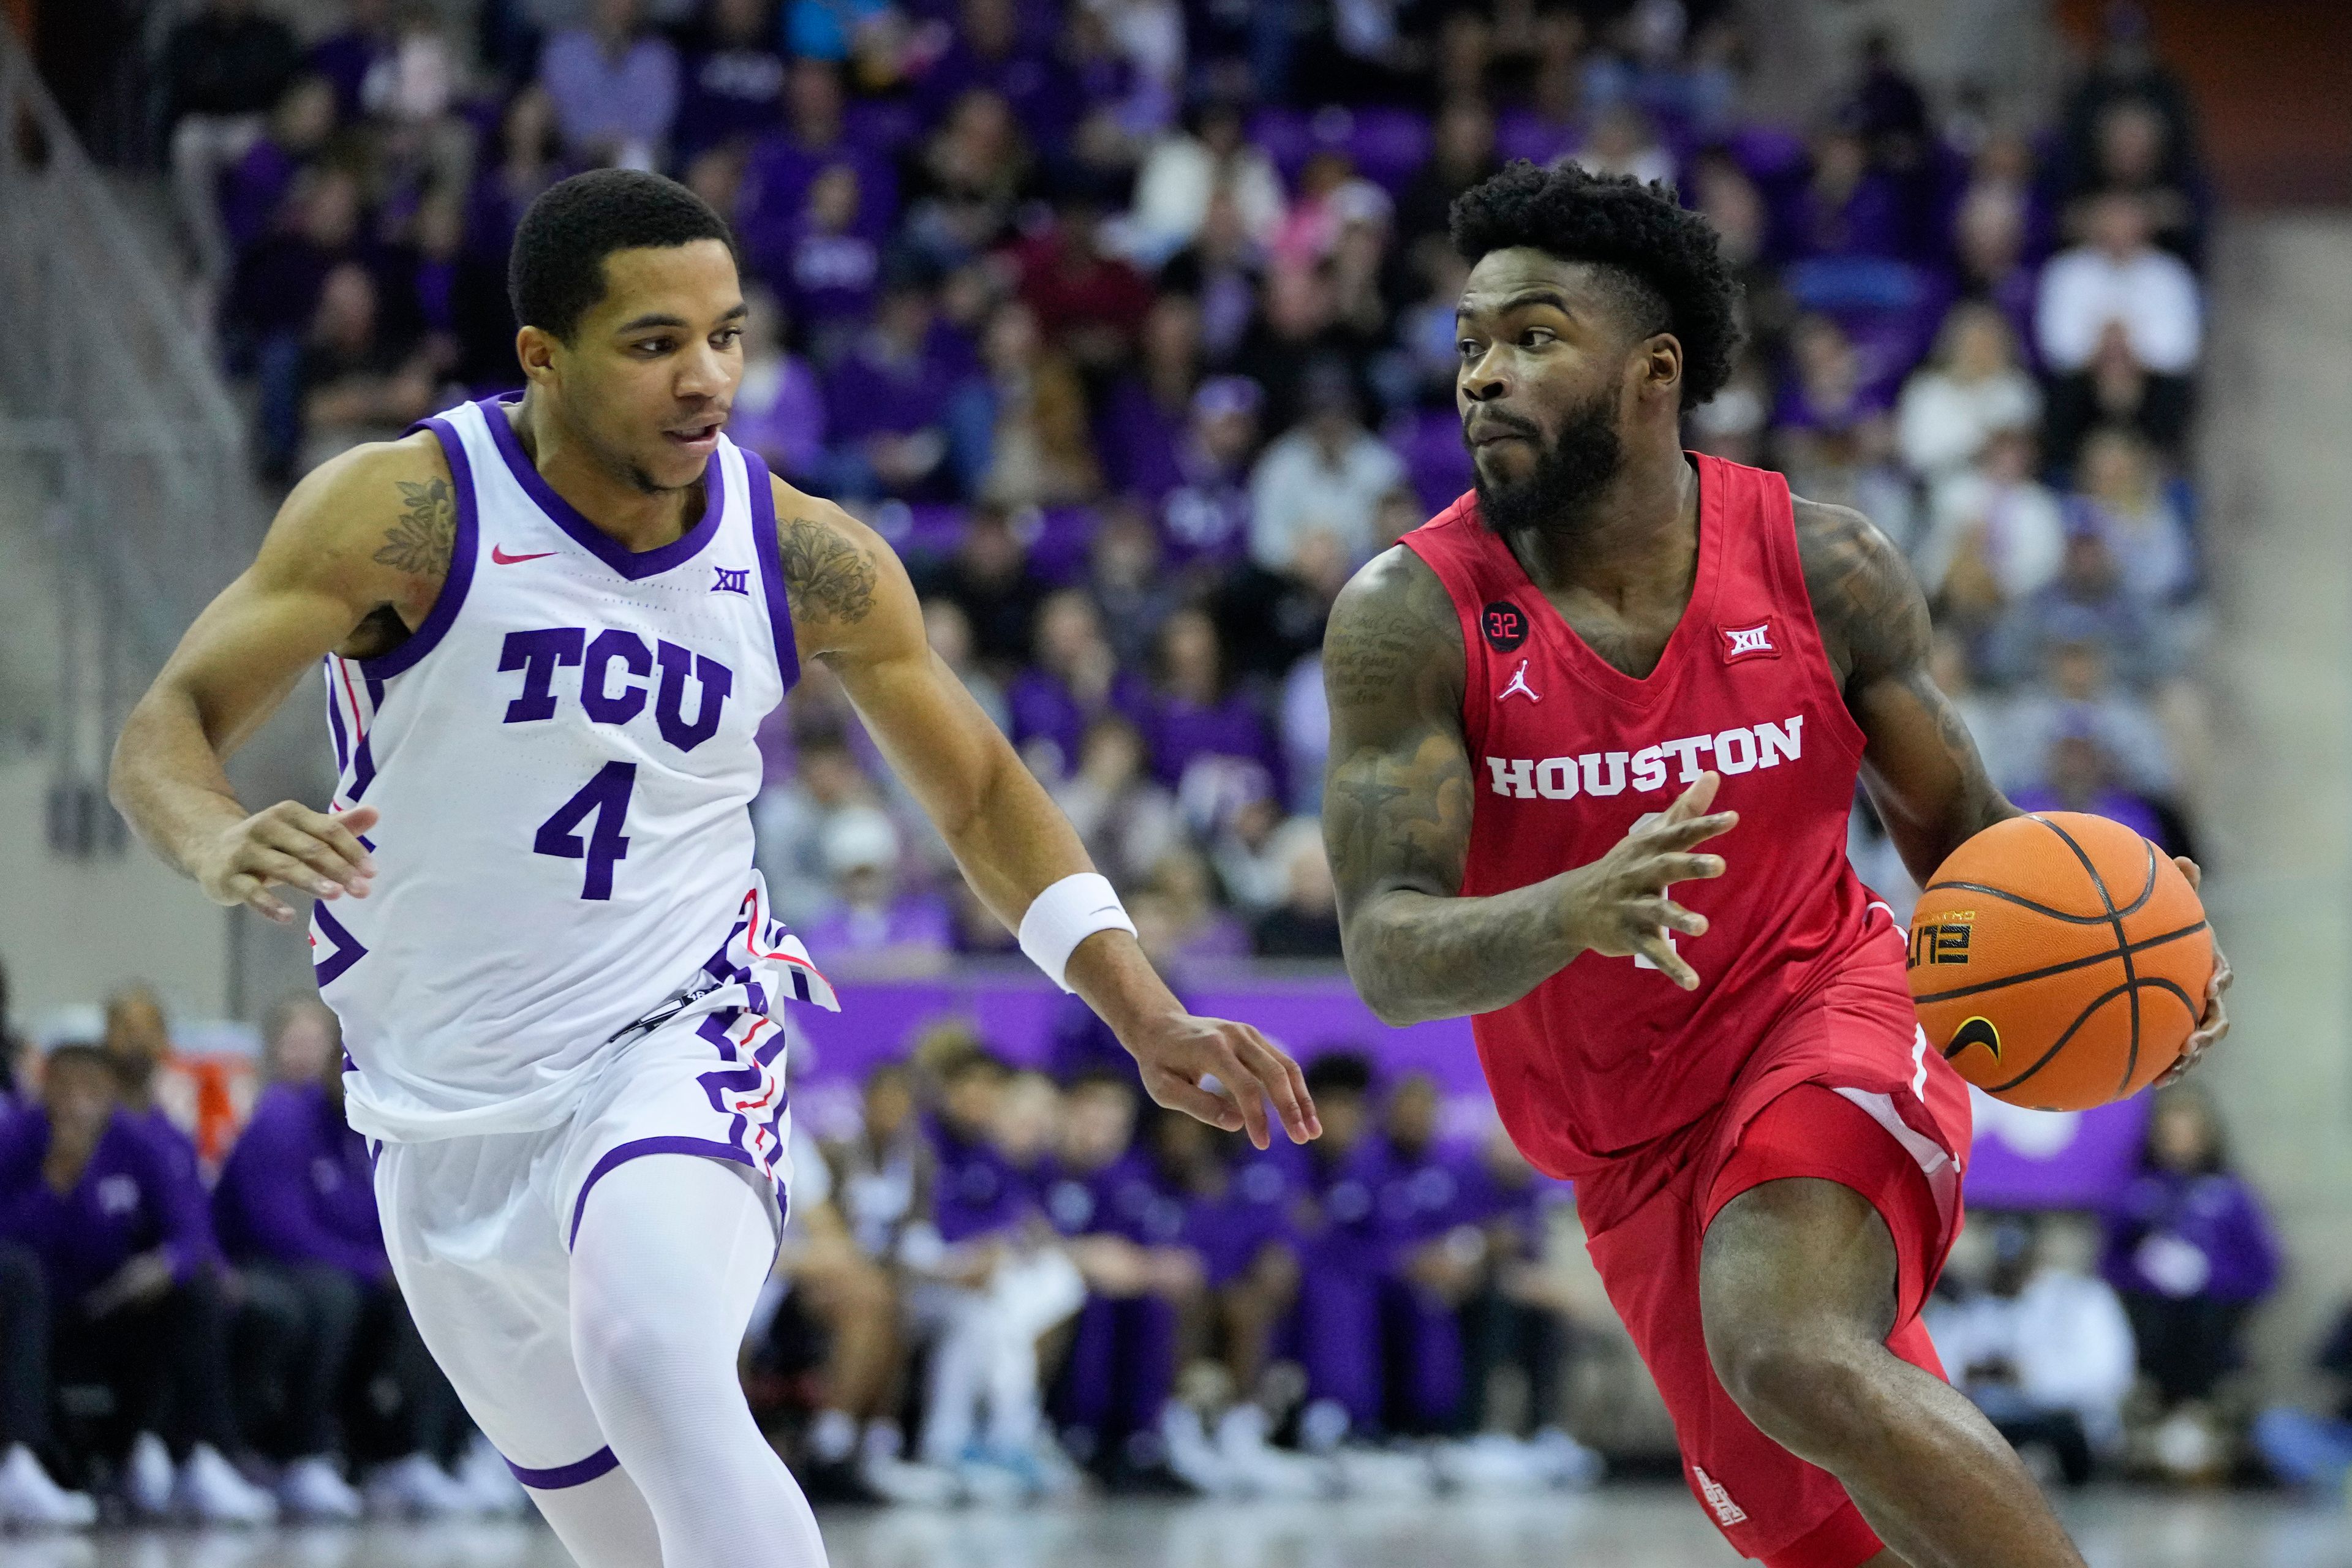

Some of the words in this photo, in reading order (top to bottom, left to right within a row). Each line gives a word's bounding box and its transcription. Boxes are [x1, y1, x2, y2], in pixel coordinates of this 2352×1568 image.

[710, 566, 750, 596] XII
[1490, 612, 1519, 638] 32
[1725, 624, 1773, 656] XII
[497, 627, 733, 753] TCU
[1487, 714, 1803, 799] HOUSTON
[532, 760, 638, 901] 4
